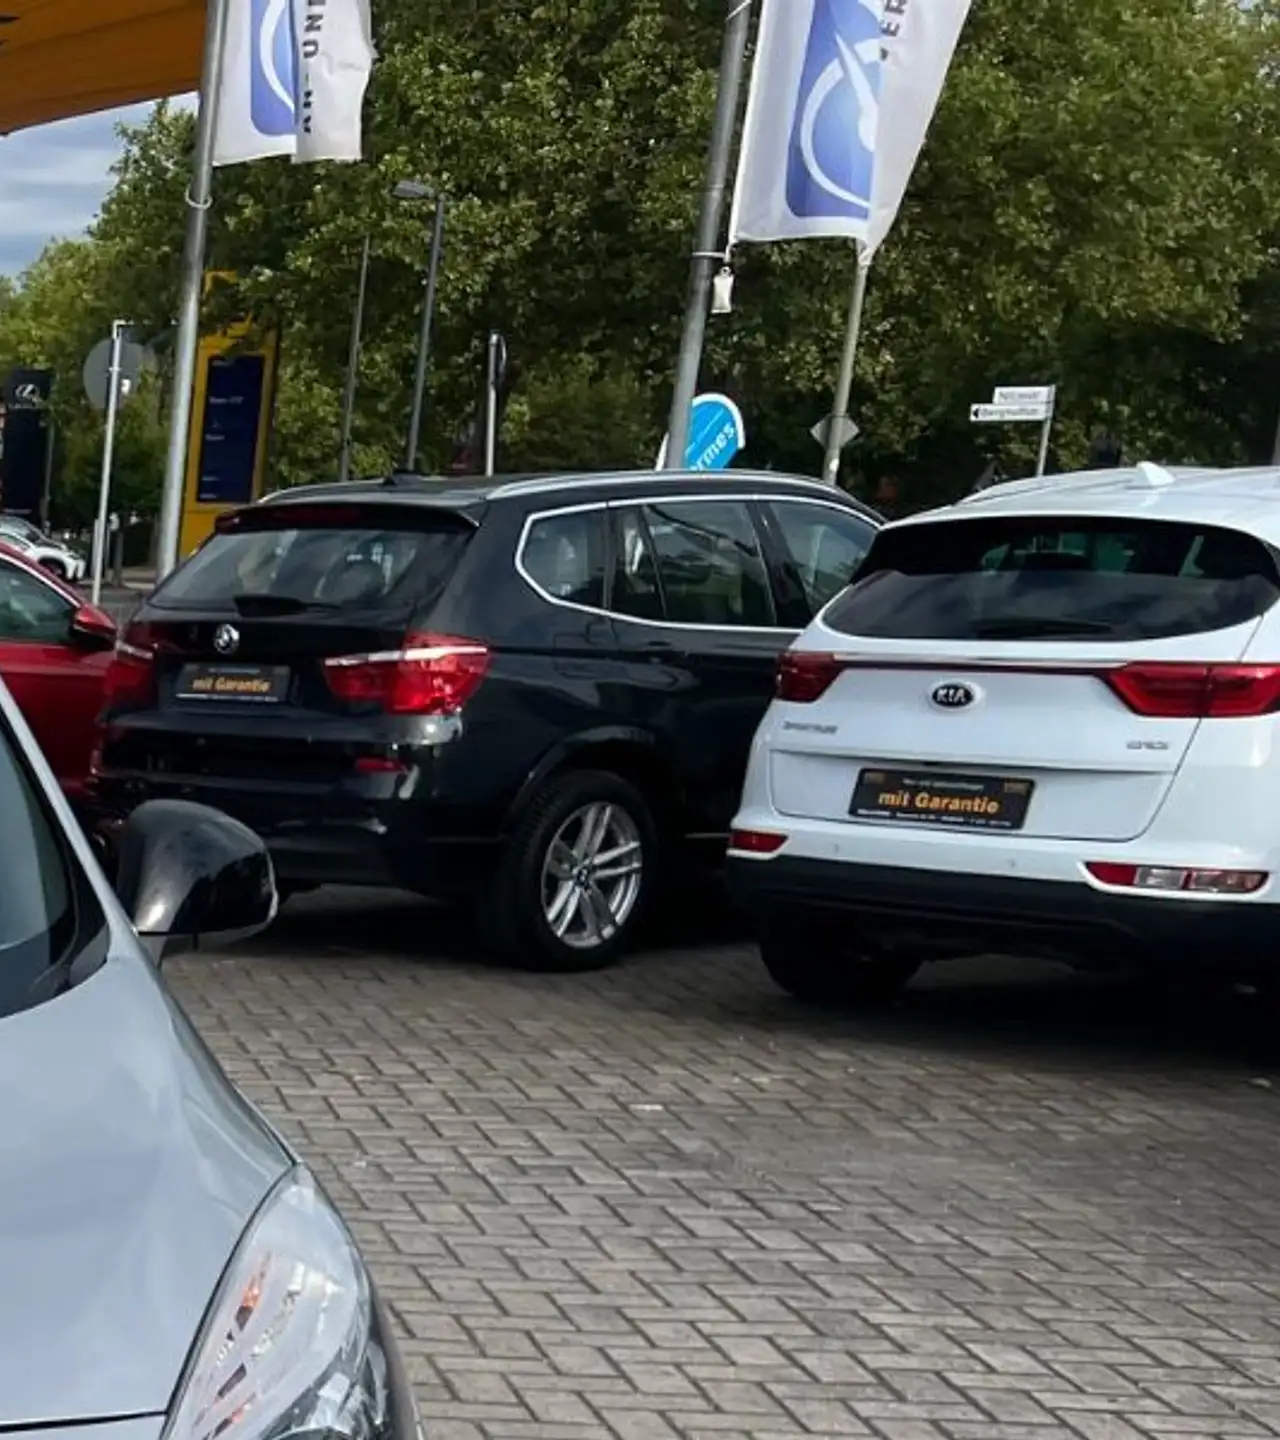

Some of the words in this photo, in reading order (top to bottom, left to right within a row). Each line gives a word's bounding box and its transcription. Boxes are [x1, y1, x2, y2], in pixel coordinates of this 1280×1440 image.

[936, 687, 967, 703] KIA
[877, 790, 911, 807] mit
[914, 791, 1001, 815] Garantie
